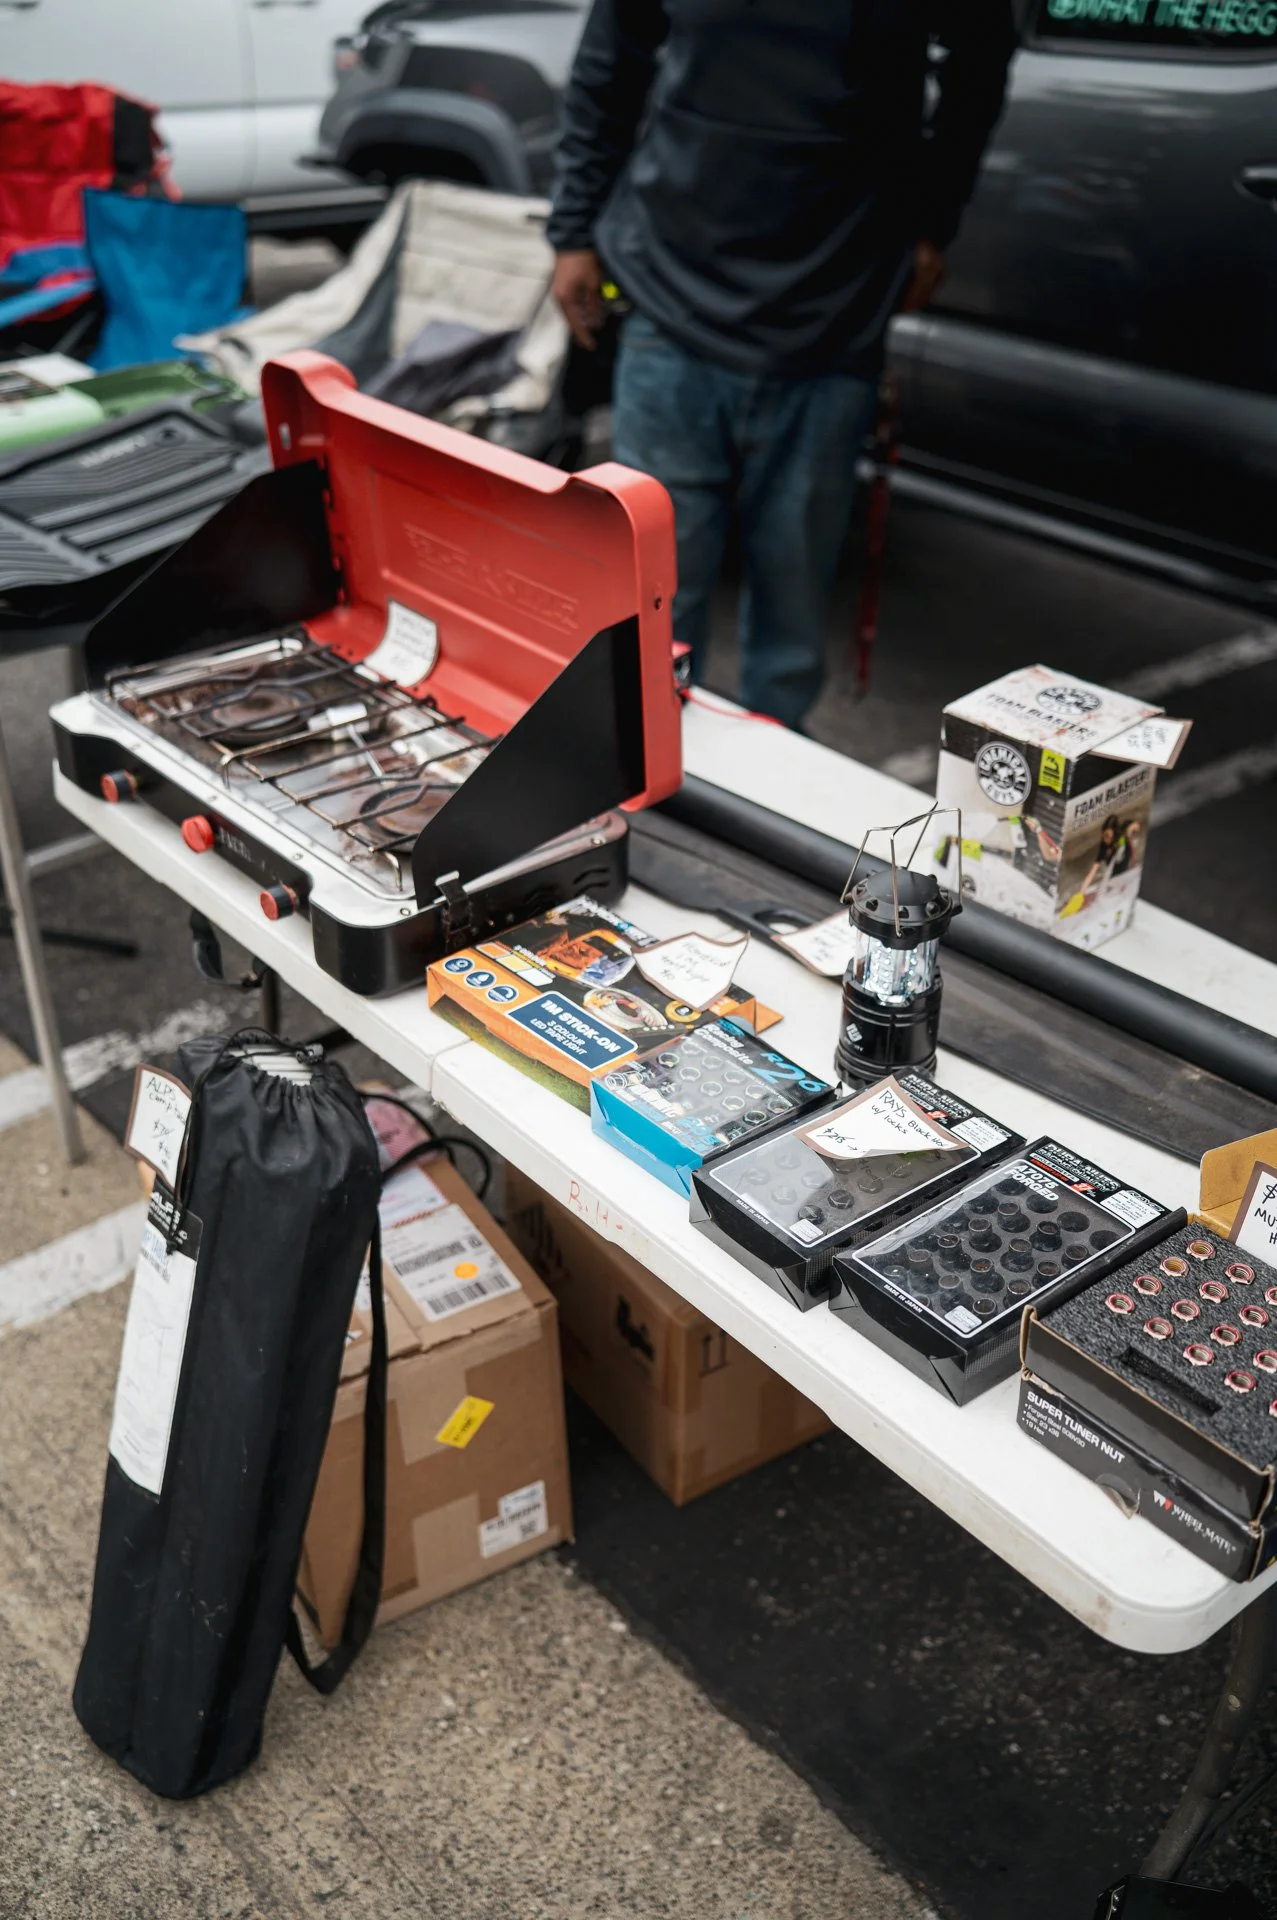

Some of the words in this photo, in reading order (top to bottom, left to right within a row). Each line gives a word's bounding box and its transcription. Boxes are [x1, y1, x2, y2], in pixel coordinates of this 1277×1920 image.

[529, 1018, 547, 1030] LED
[544, 1026, 566, 1042] TAPE
[562, 1040, 588, 1056] LIGHT
[540, 999, 564, 1016] 1M
[558, 1011, 621, 1053] STICK-ON
[547, 1019, 556, 1028] 3
[552, 1023, 586, 1046] COLOUR
[702, 1023, 745, 1049] Racing
[693, 1028, 754, 1065] Composite
[879, 1089, 908, 1119] RAYS
[907, 1120, 933, 1140] Black
[884, 1114, 908, 1135] locks
[1004, 1168, 1060, 1201] FORGED
[1013, 1164, 1060, 1189] A7075
[883, 1283, 899, 1297] MADE
[904, 1299, 923, 1314] JAPAN
[1027, 1404, 1048, 1421] Forged
[1027, 1391, 1063, 1420] SUPER
[1064, 1414, 1100, 1447] TUNER
[1100, 1441, 1125, 1463] NUT
